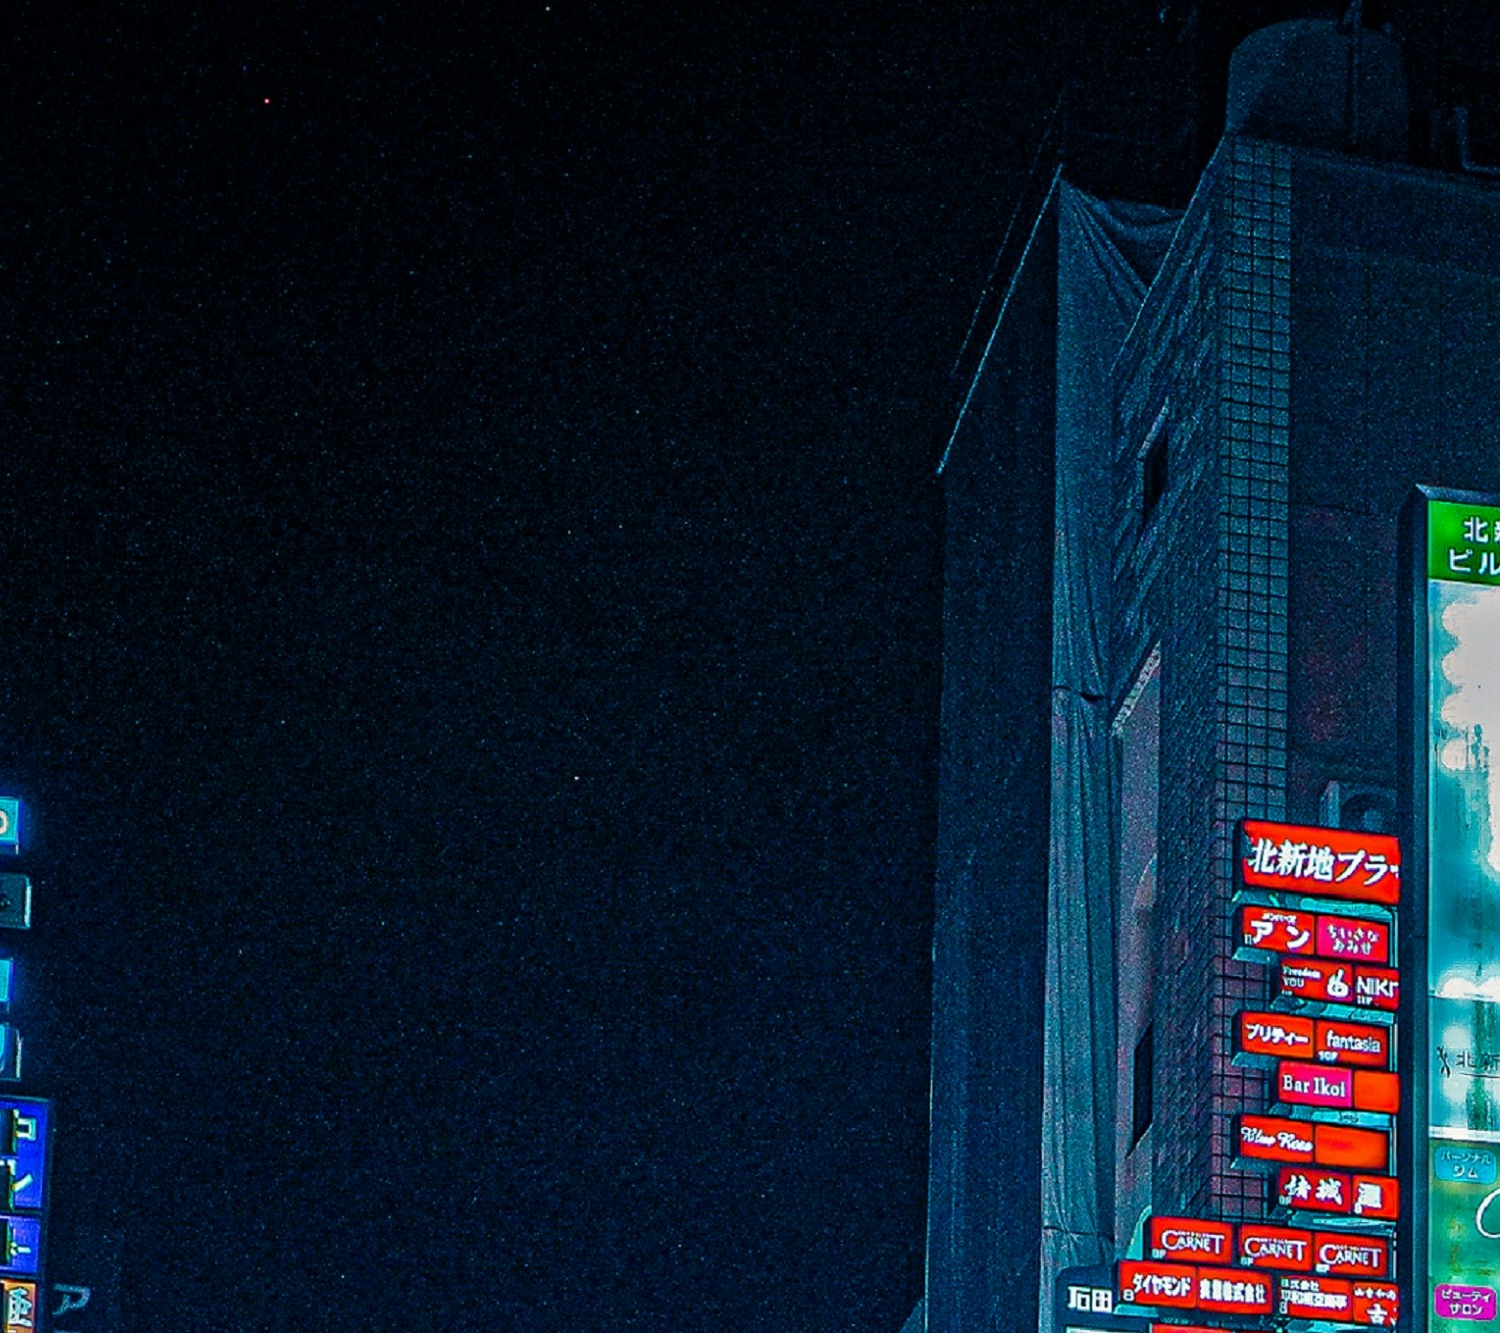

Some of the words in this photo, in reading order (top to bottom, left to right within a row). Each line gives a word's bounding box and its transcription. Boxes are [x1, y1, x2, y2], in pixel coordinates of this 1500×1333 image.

[1248, 838, 1400, 886] 北新地プラ
[1251, 921, 1310, 949] アン
[1326, 1030, 1381, 1053] fantasia
[1283, 1075, 1311, 1094] Bar
[1441, 1152, 1491, 1167] パーソナル
[1452, 1165, 1478, 1179] ジム
[1161, 1229, 1225, 1254] CARNET
[1244, 1236, 1307, 1261] CARNET
[1318, 1243, 1382, 1268] CARNET
[1442, 1287, 1491, 1302] ビューティ
[1450, 1302, 1484, 1316] サロン
